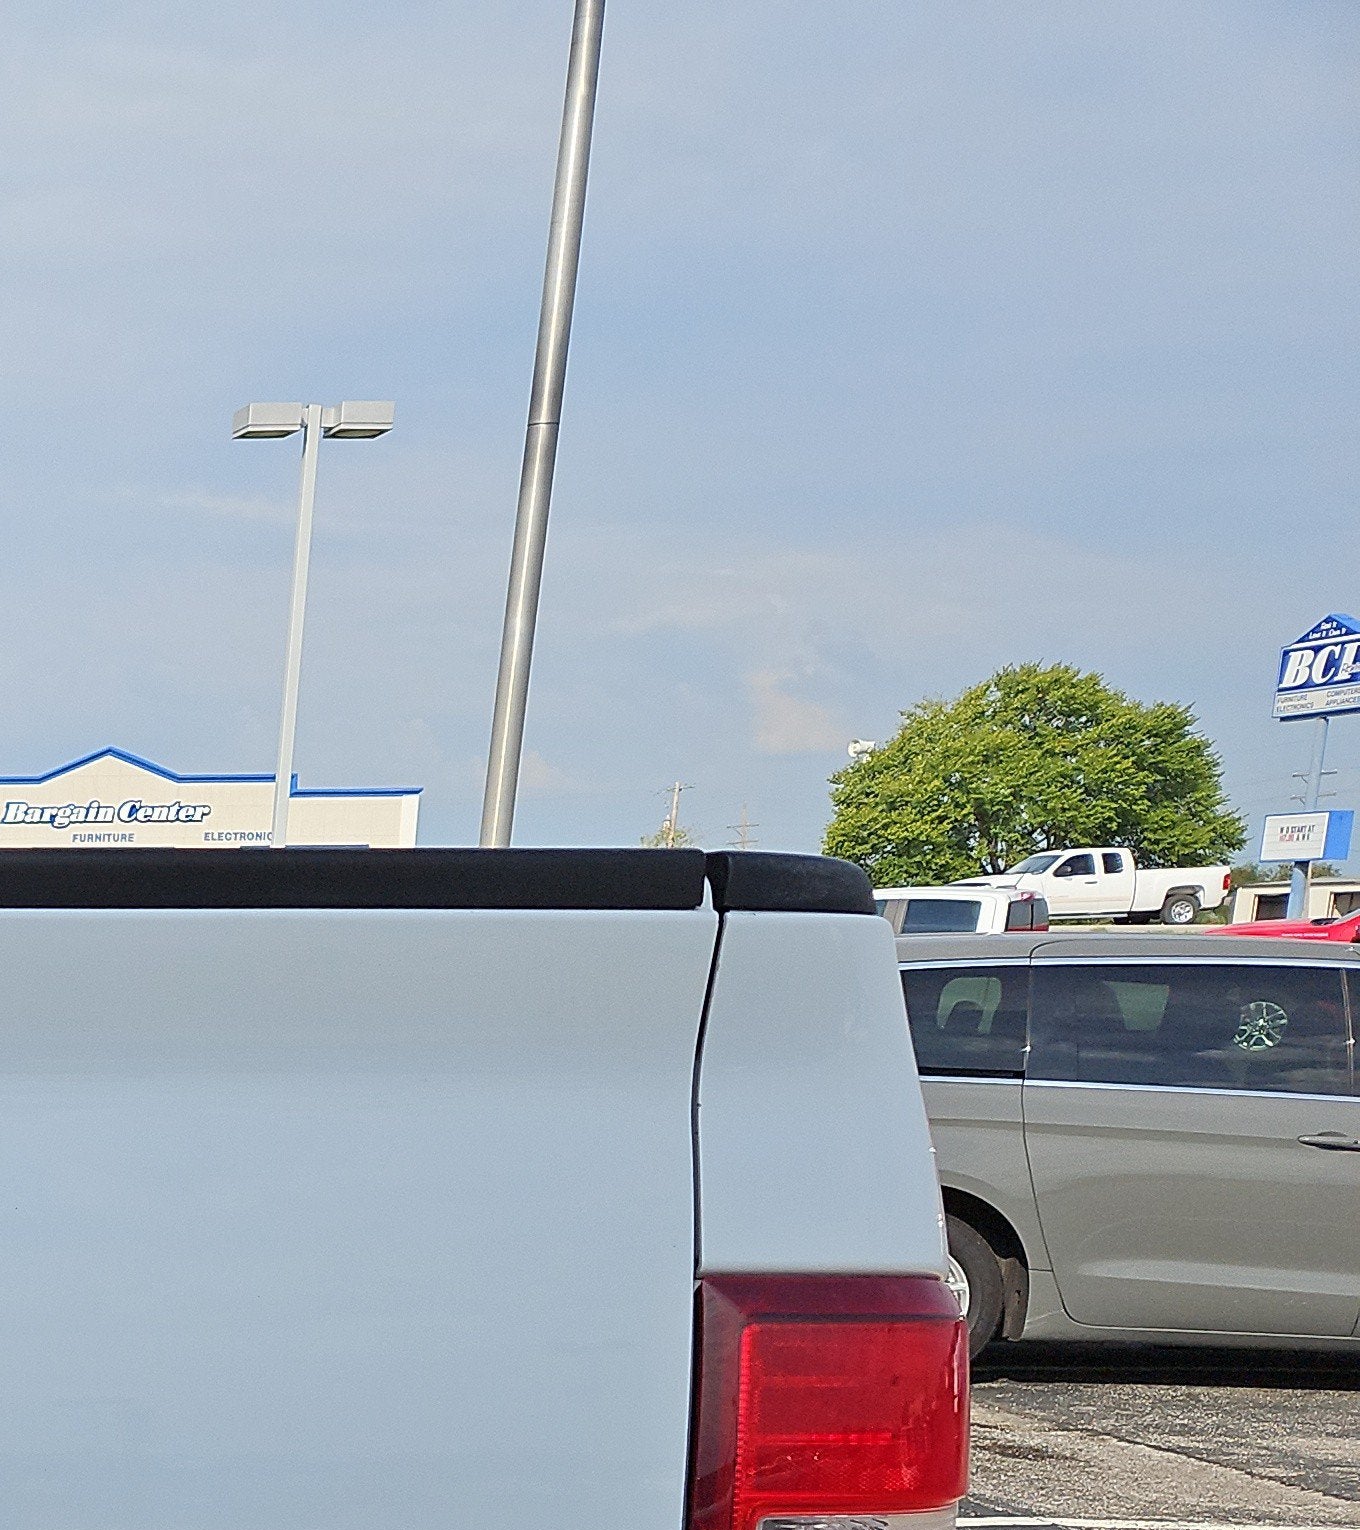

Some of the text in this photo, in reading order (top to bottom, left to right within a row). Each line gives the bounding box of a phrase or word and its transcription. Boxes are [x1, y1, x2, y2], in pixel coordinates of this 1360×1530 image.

[0, 800, 212, 829] Bargain Center
[71, 833, 135, 843] FURNITURE
